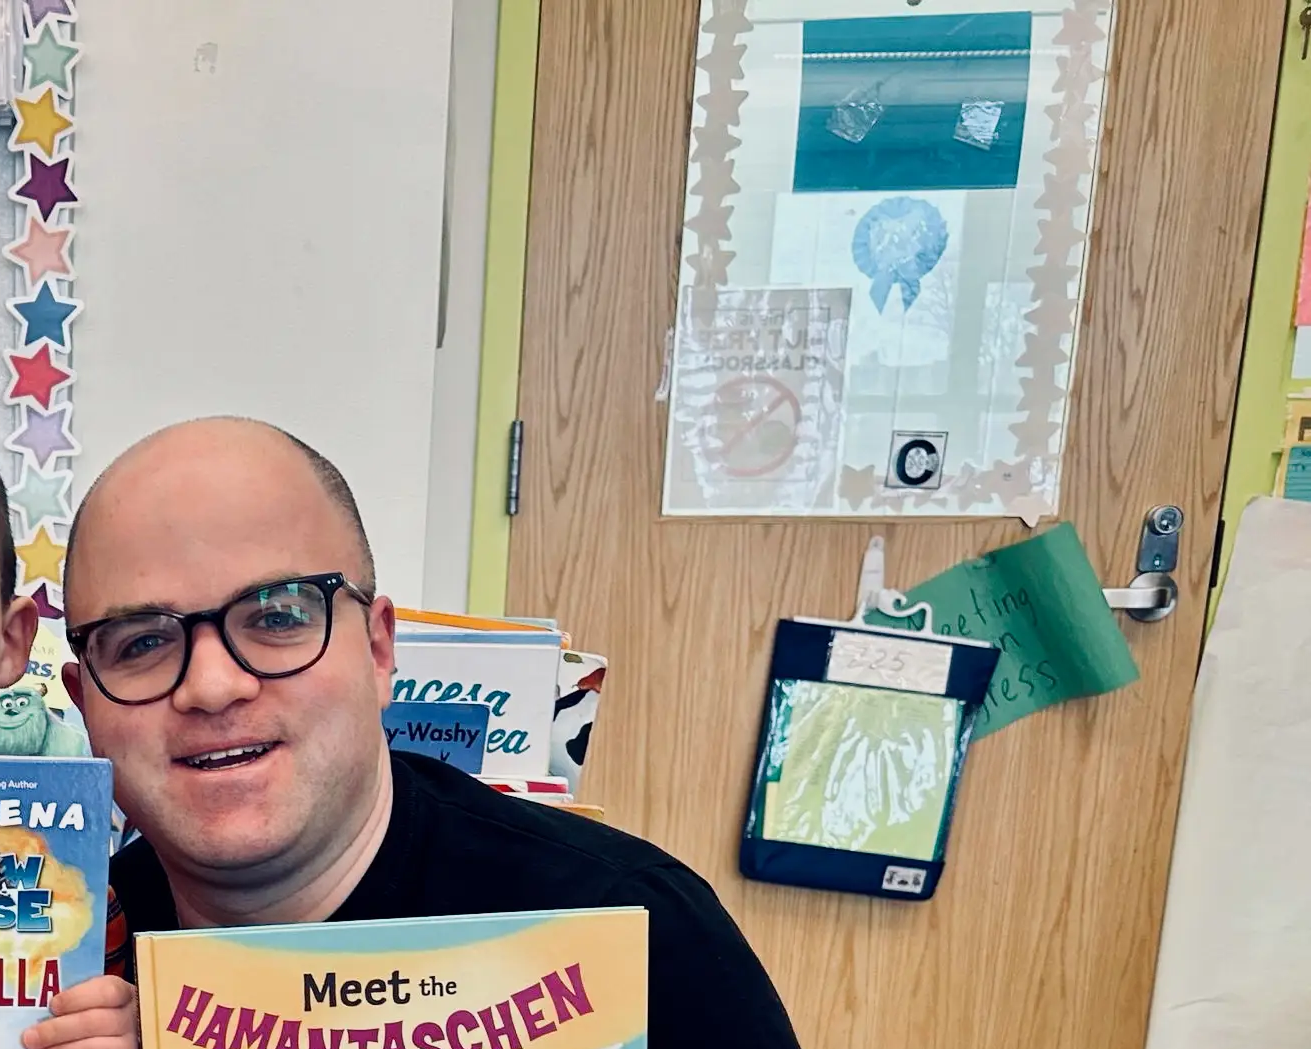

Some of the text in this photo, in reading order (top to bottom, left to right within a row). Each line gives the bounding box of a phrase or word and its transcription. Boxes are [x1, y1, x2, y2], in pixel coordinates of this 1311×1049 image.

[8, 780, 38, 789] Author
[303, 970, 457, 1011] Meet the
